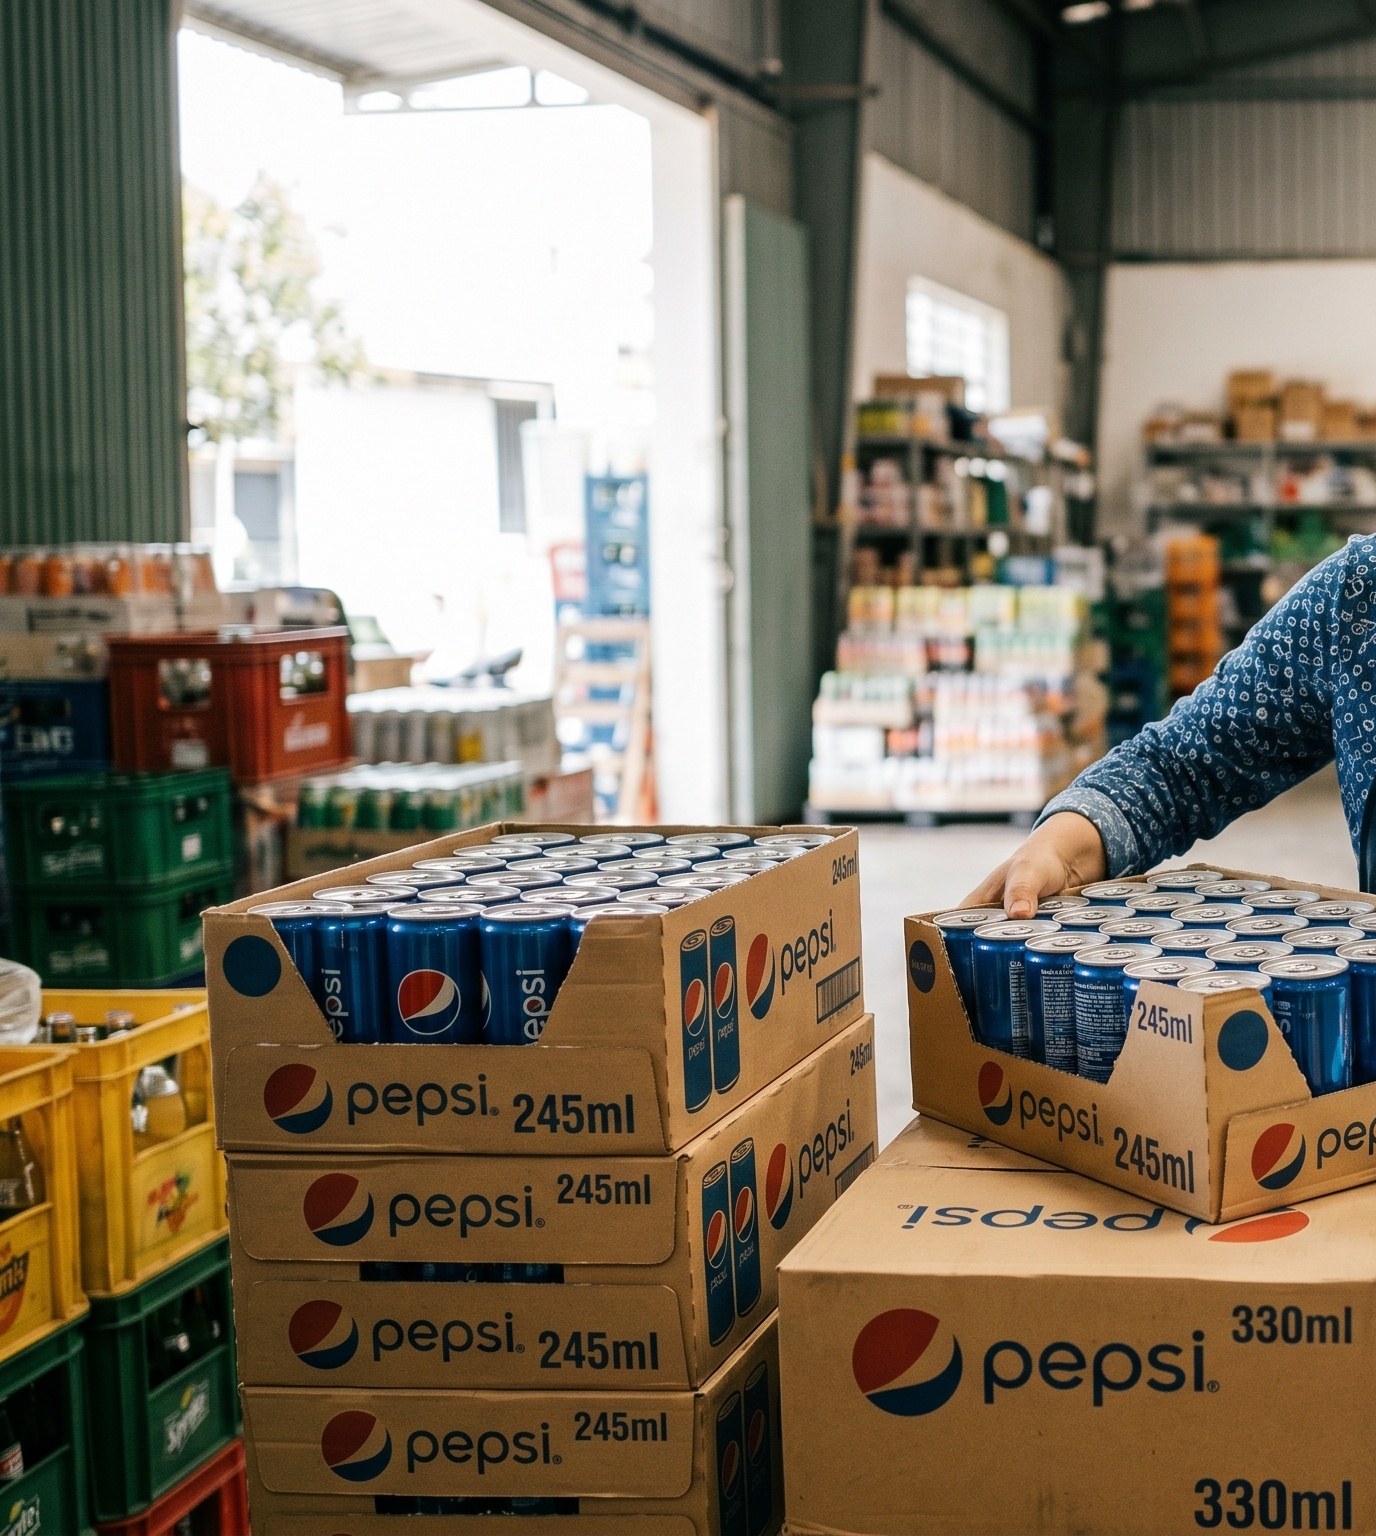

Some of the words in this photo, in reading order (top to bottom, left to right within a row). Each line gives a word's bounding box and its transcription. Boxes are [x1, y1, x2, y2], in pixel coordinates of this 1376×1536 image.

[832, 850, 858, 886] 245ml
[780, 909, 836, 996] pepsi
[321, 968, 349, 1044] epsi
[1137, 1000, 1194, 1044] 245ml
[850, 1036, 873, 1077] 245ml
[348, 1074, 489, 1126] pepsi
[512, 1093, 635, 1134] 245ml
[800, 1098, 853, 1199] pepsi
[1019, 1090, 1100, 1145] pepsi
[1112, 1126, 1195, 1194] 245ml
[389, 1185, 535, 1238] pepsi
[556, 1173, 651, 1205] 245ml
[902, 1204, 1164, 1232] pepsi
[372, 1312, 515, 1362] pepsi
[538, 1331, 659, 1370] 245ml
[984, 1330, 1206, 1407] pepsi
[1231, 1305, 1352, 1345] 330ml
[407, 1422, 552, 1475] pepsi
[574, 1411, 668, 1442] 245ml
[1194, 1477, 1352, 1531] 330ml
